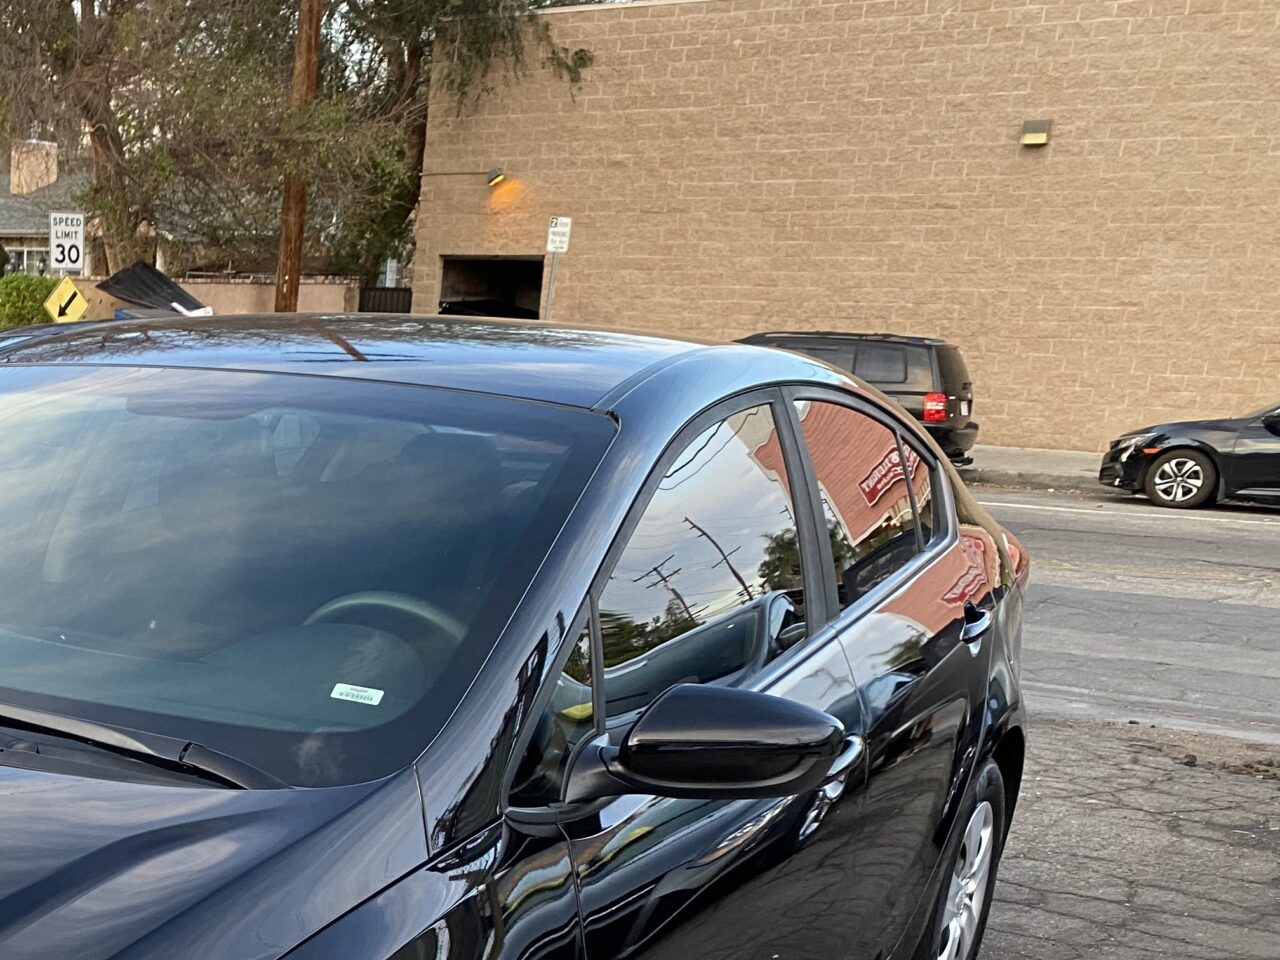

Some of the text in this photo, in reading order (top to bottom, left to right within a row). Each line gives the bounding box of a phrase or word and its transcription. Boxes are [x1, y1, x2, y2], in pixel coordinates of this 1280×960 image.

[52, 215, 82, 227] SPEED
[55, 230, 79, 240] LIMIT
[54, 243, 80, 264] 30
